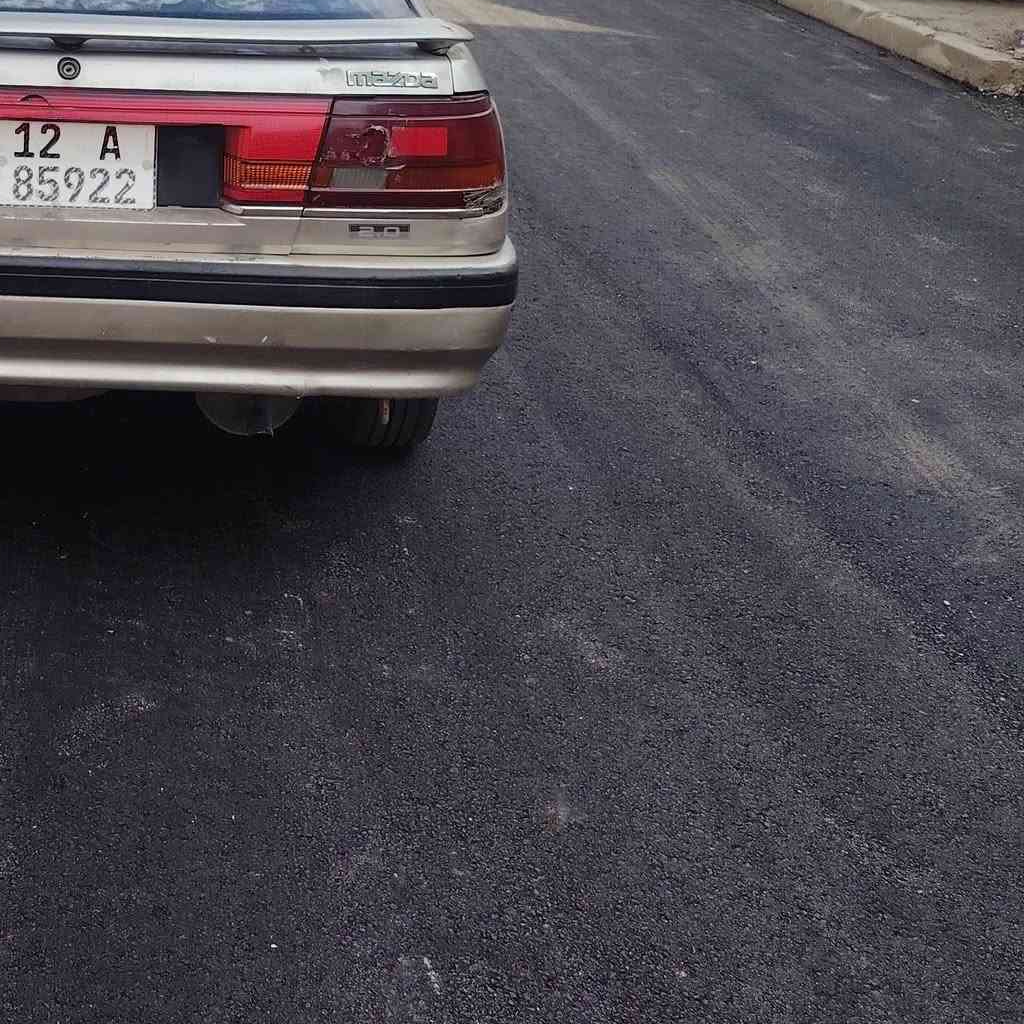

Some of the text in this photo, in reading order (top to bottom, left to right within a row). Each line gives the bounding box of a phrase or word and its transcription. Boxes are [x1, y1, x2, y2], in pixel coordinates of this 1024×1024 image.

[14, 122, 121, 160] 12 A
[12, 164, 137, 205] 85922
